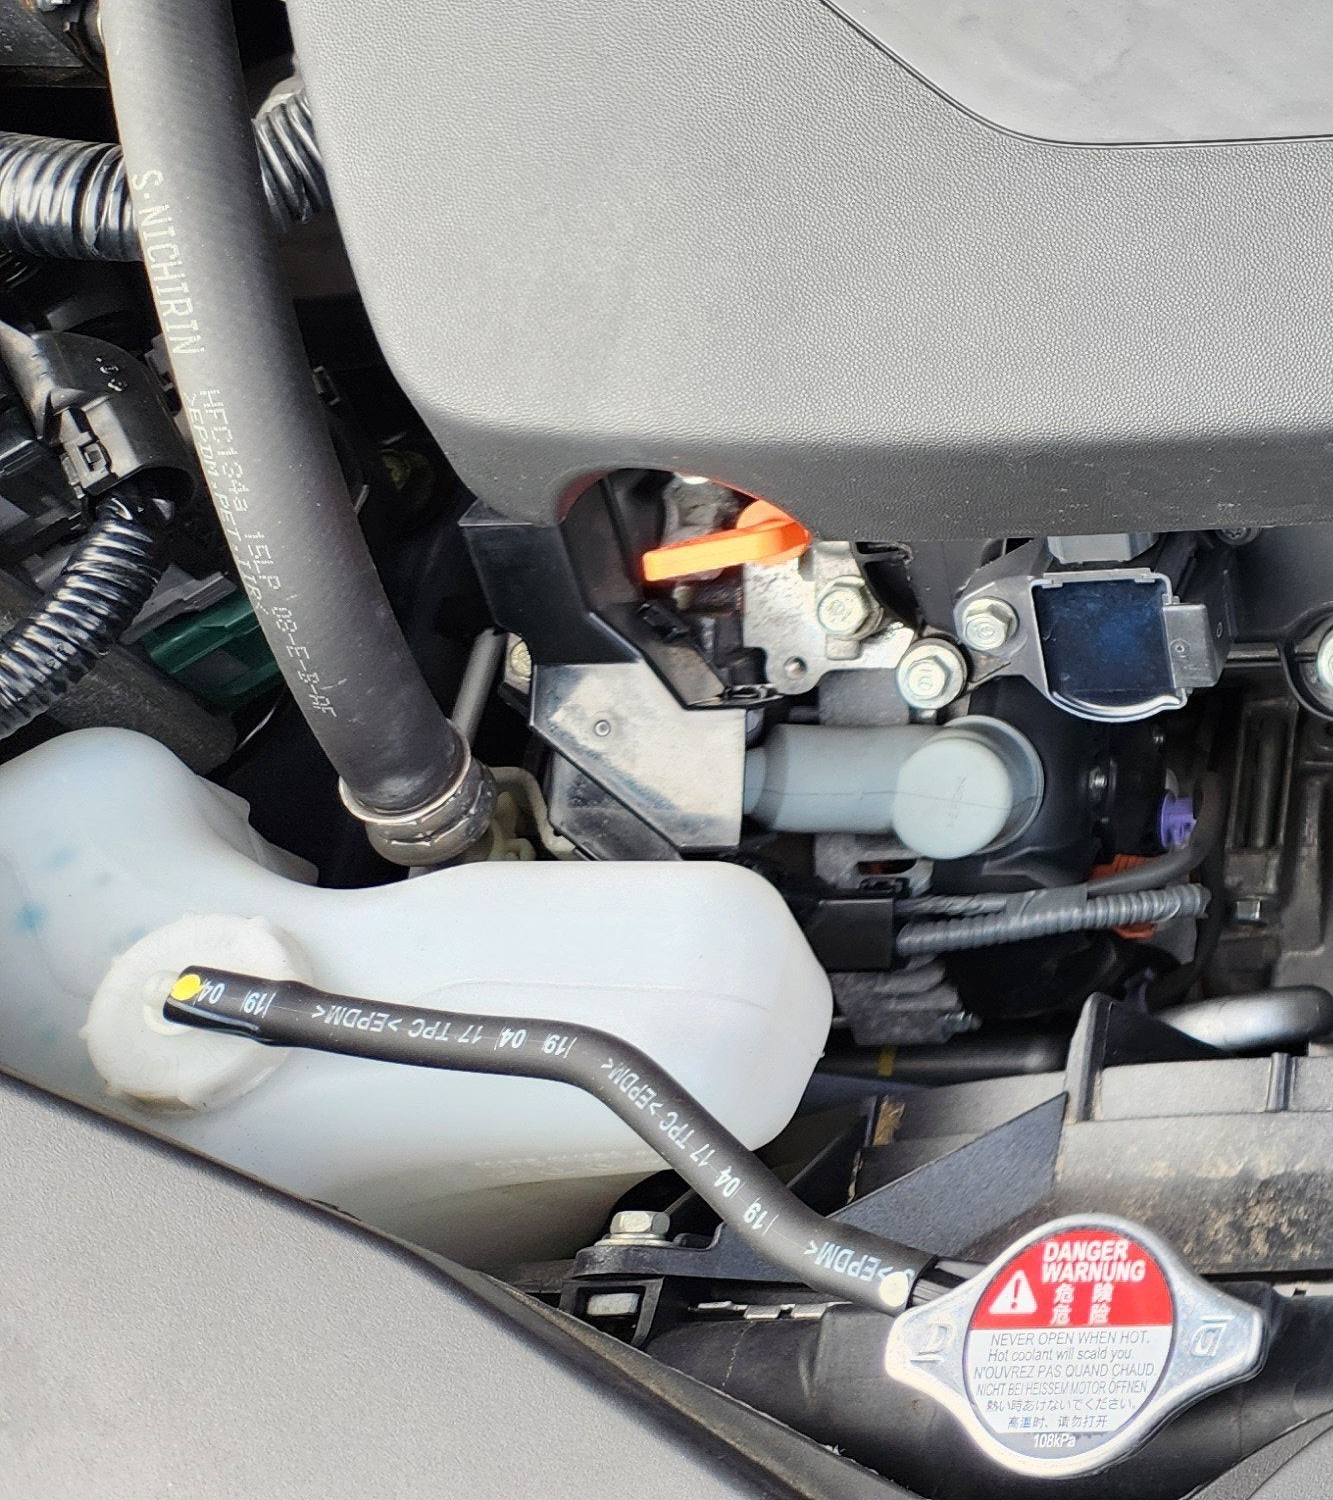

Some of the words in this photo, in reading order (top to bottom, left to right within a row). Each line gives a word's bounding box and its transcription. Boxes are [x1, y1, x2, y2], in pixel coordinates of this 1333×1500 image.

[408, 1018, 451, 1042] TPC
[457, 1025, 485, 1044] 17
[658, 1111, 695, 1150] TPC
[1043, 1240, 1130, 1262] DANGER
[1041, 1260, 1147, 1283] WARNUNG
[991, 1332, 1034, 1347] NEVER
[1038, 1331, 1073, 1346] OPEN
[1078, 1331, 1116, 1345] WHEN
[1120, 1330, 1150, 1345] HOT.
[988, 1349, 1009, 1363] Hot
[1011, 1348, 1052, 1362] coolant
[1056, 1347, 1073, 1361] will
[1077, 1346, 1107, 1361] scald
[1110, 1348, 1134, 1363] you.
[1037, 1364, 1062, 1378] PAS
[1065, 1364, 1109, 1378] QUAND
[976, 1383, 1005, 1397] NICHT
[1008, 1382, 1024, 1396] BEI
[1071, 1380, 1106, 1395] MOTOR
[1033, 1433, 1076, 1448] 108kPa
